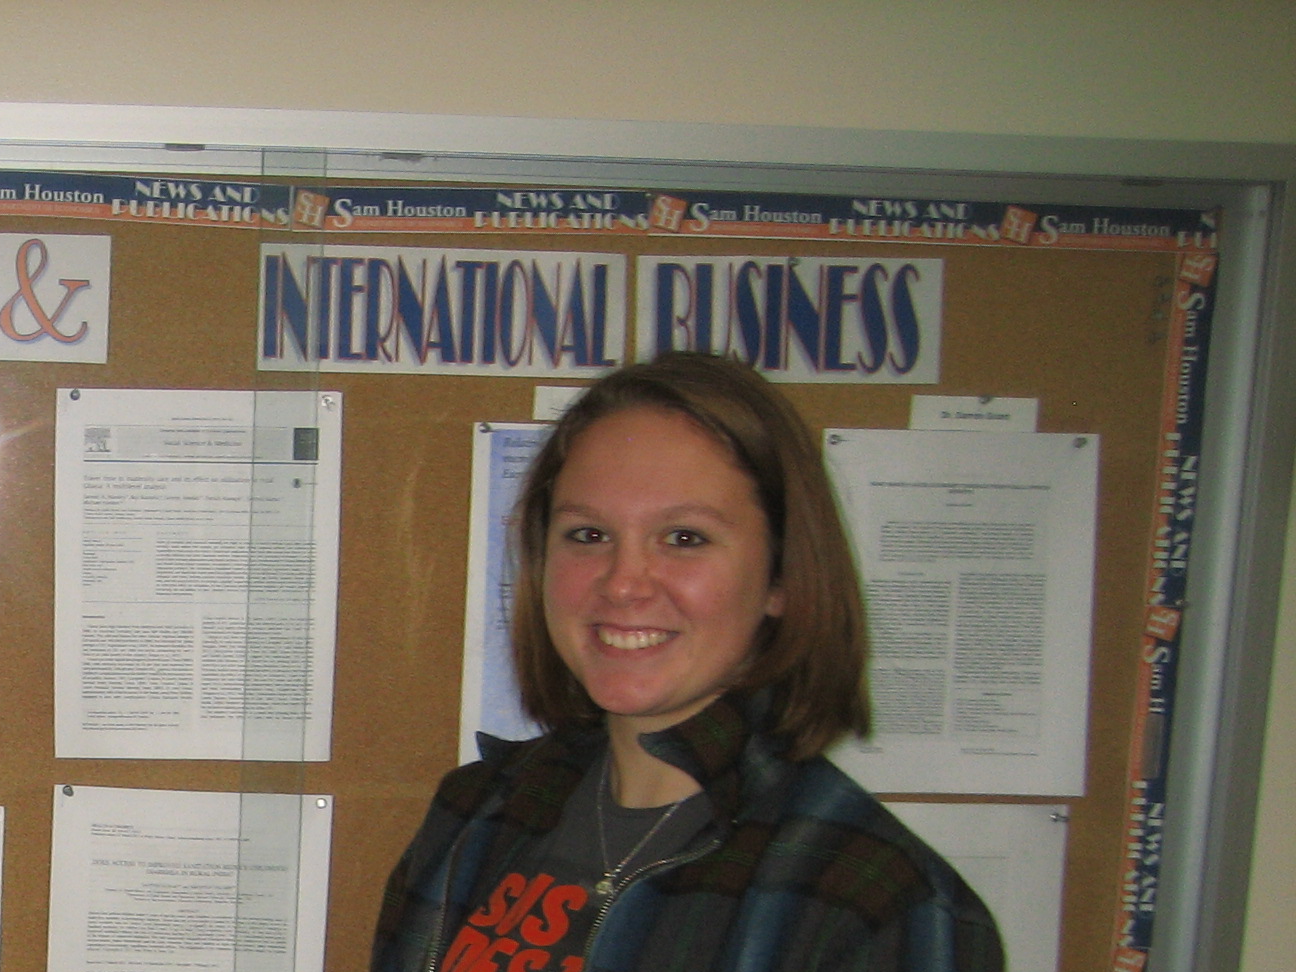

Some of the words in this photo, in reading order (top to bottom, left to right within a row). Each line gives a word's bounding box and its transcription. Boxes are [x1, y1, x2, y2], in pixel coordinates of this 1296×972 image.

[24, 183, 104, 204] Houston
[134, 179, 202, 201] NEWS
[209, 183, 259, 203] AND
[496, 192, 565, 210] NEWS
[571, 193, 620, 211] AND
[111, 198, 290, 225] PUBLICATIONS
[333, 198, 379, 229] Sam
[386, 200, 466, 219] Houston
[473, 211, 650, 231] PUBLICATIONS
[689, 202, 737, 232] Sam
[743, 204, 822, 225] Houston
[851, 199, 919, 219] NEWS
[924, 202, 972, 221] AND
[1039, 214, 1086, 245] Sam
[1093, 217, 1171, 237] Houston
[263, 252, 616, 368] INTERNATIONAL
[657, 260, 920, 374] BUSINESS
